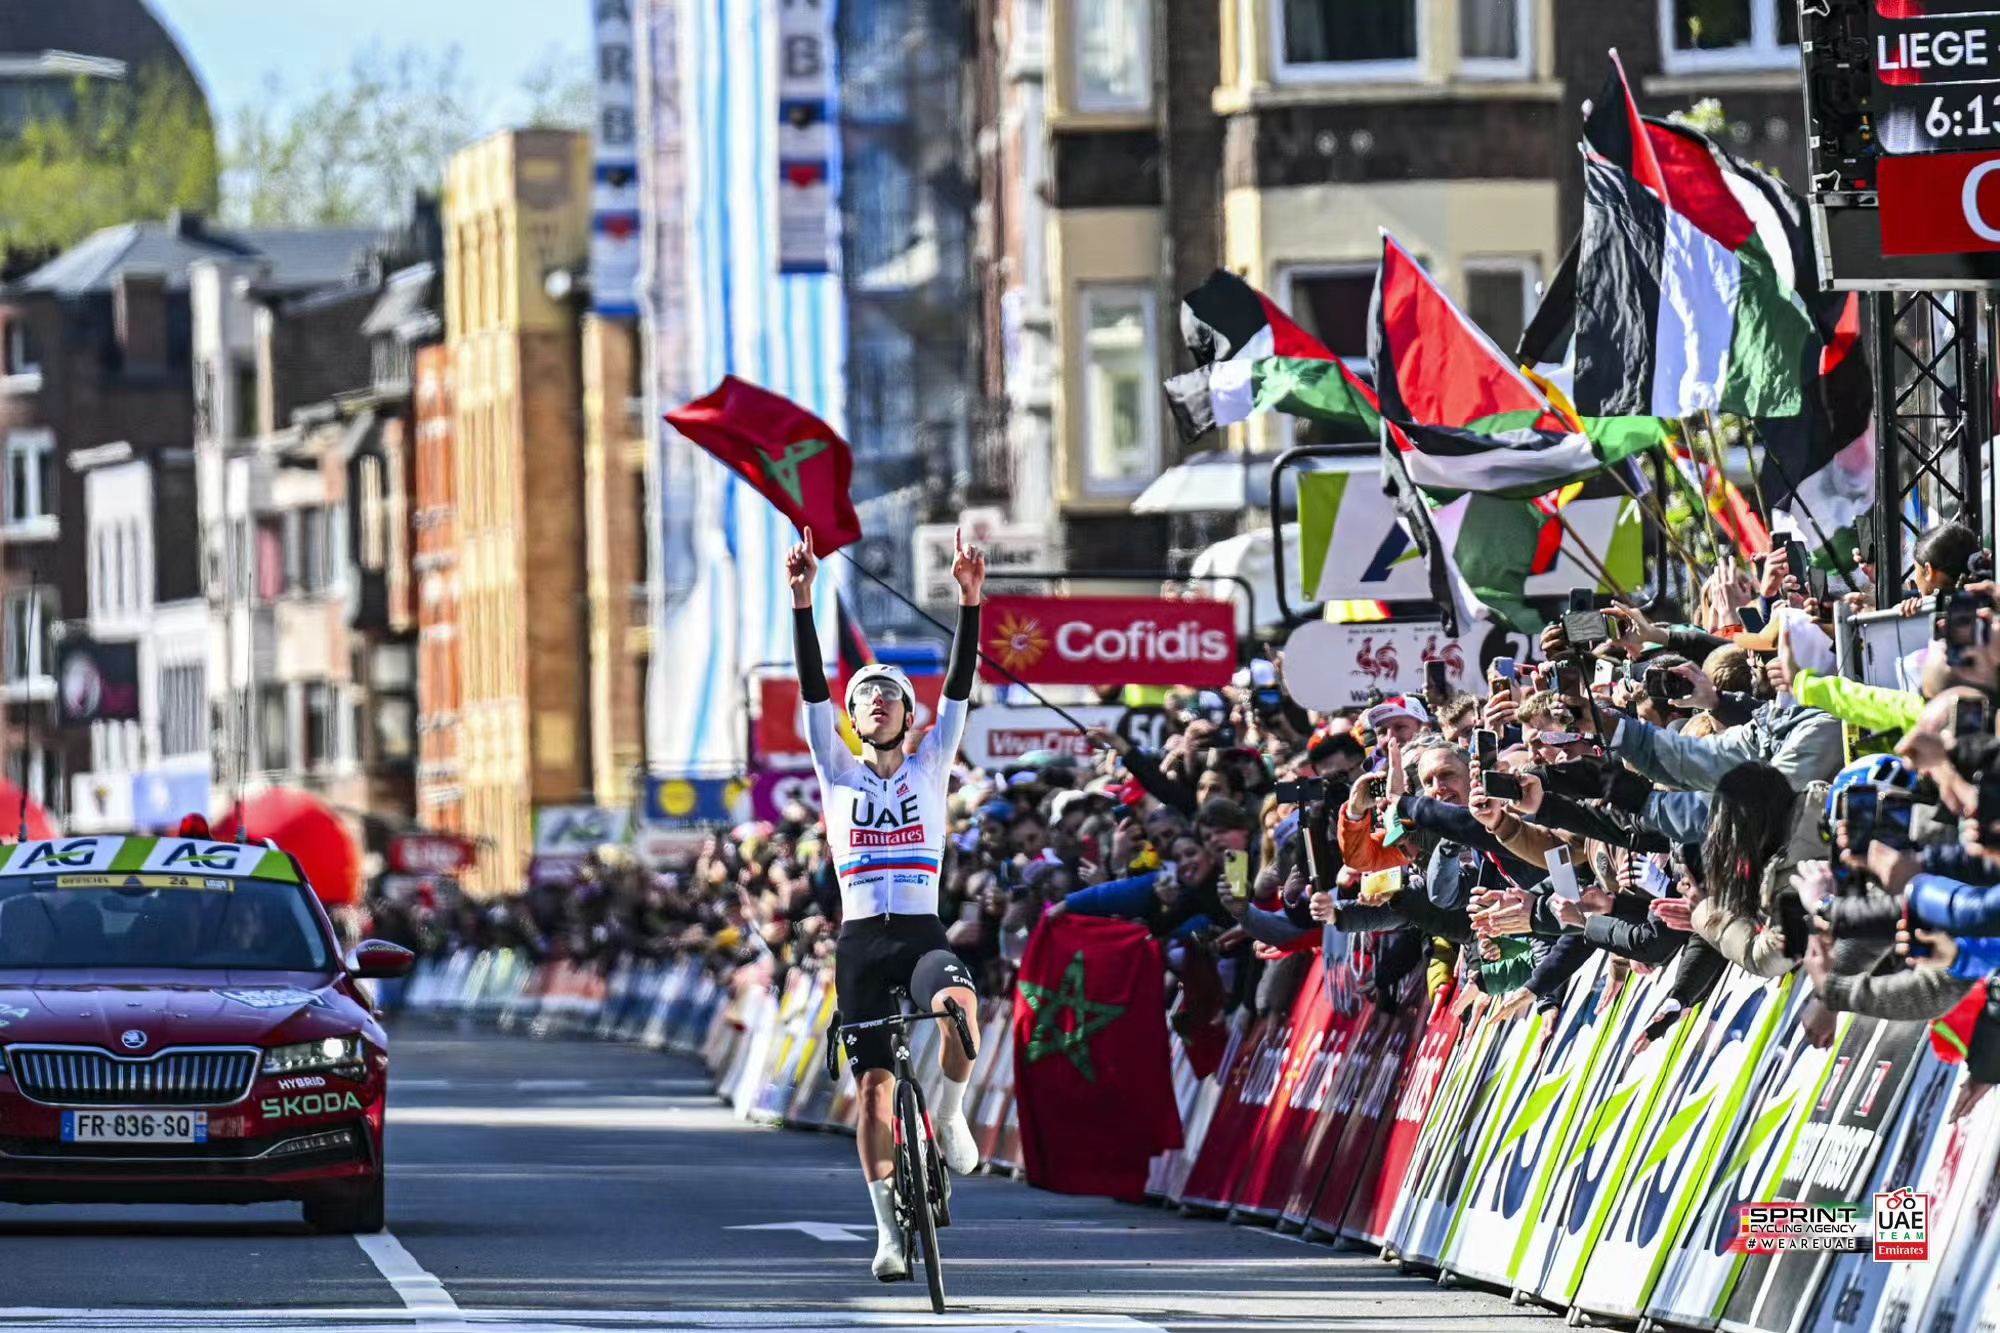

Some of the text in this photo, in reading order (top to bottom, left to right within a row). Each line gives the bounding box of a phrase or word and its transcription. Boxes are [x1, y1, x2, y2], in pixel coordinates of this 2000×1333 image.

[1877, 29, 1988, 71] LIEGE
[1056, 621, 1229, 661] Cofidis
[851, 794, 920, 828] UAE
[853, 829, 923, 845] Emirates
[19, 839, 98, 869] AG
[162, 842, 240, 869] AG
[278, 1077, 327, 1090] HYBRID
[77, 1114, 190, 1138] FR-836-SQ
